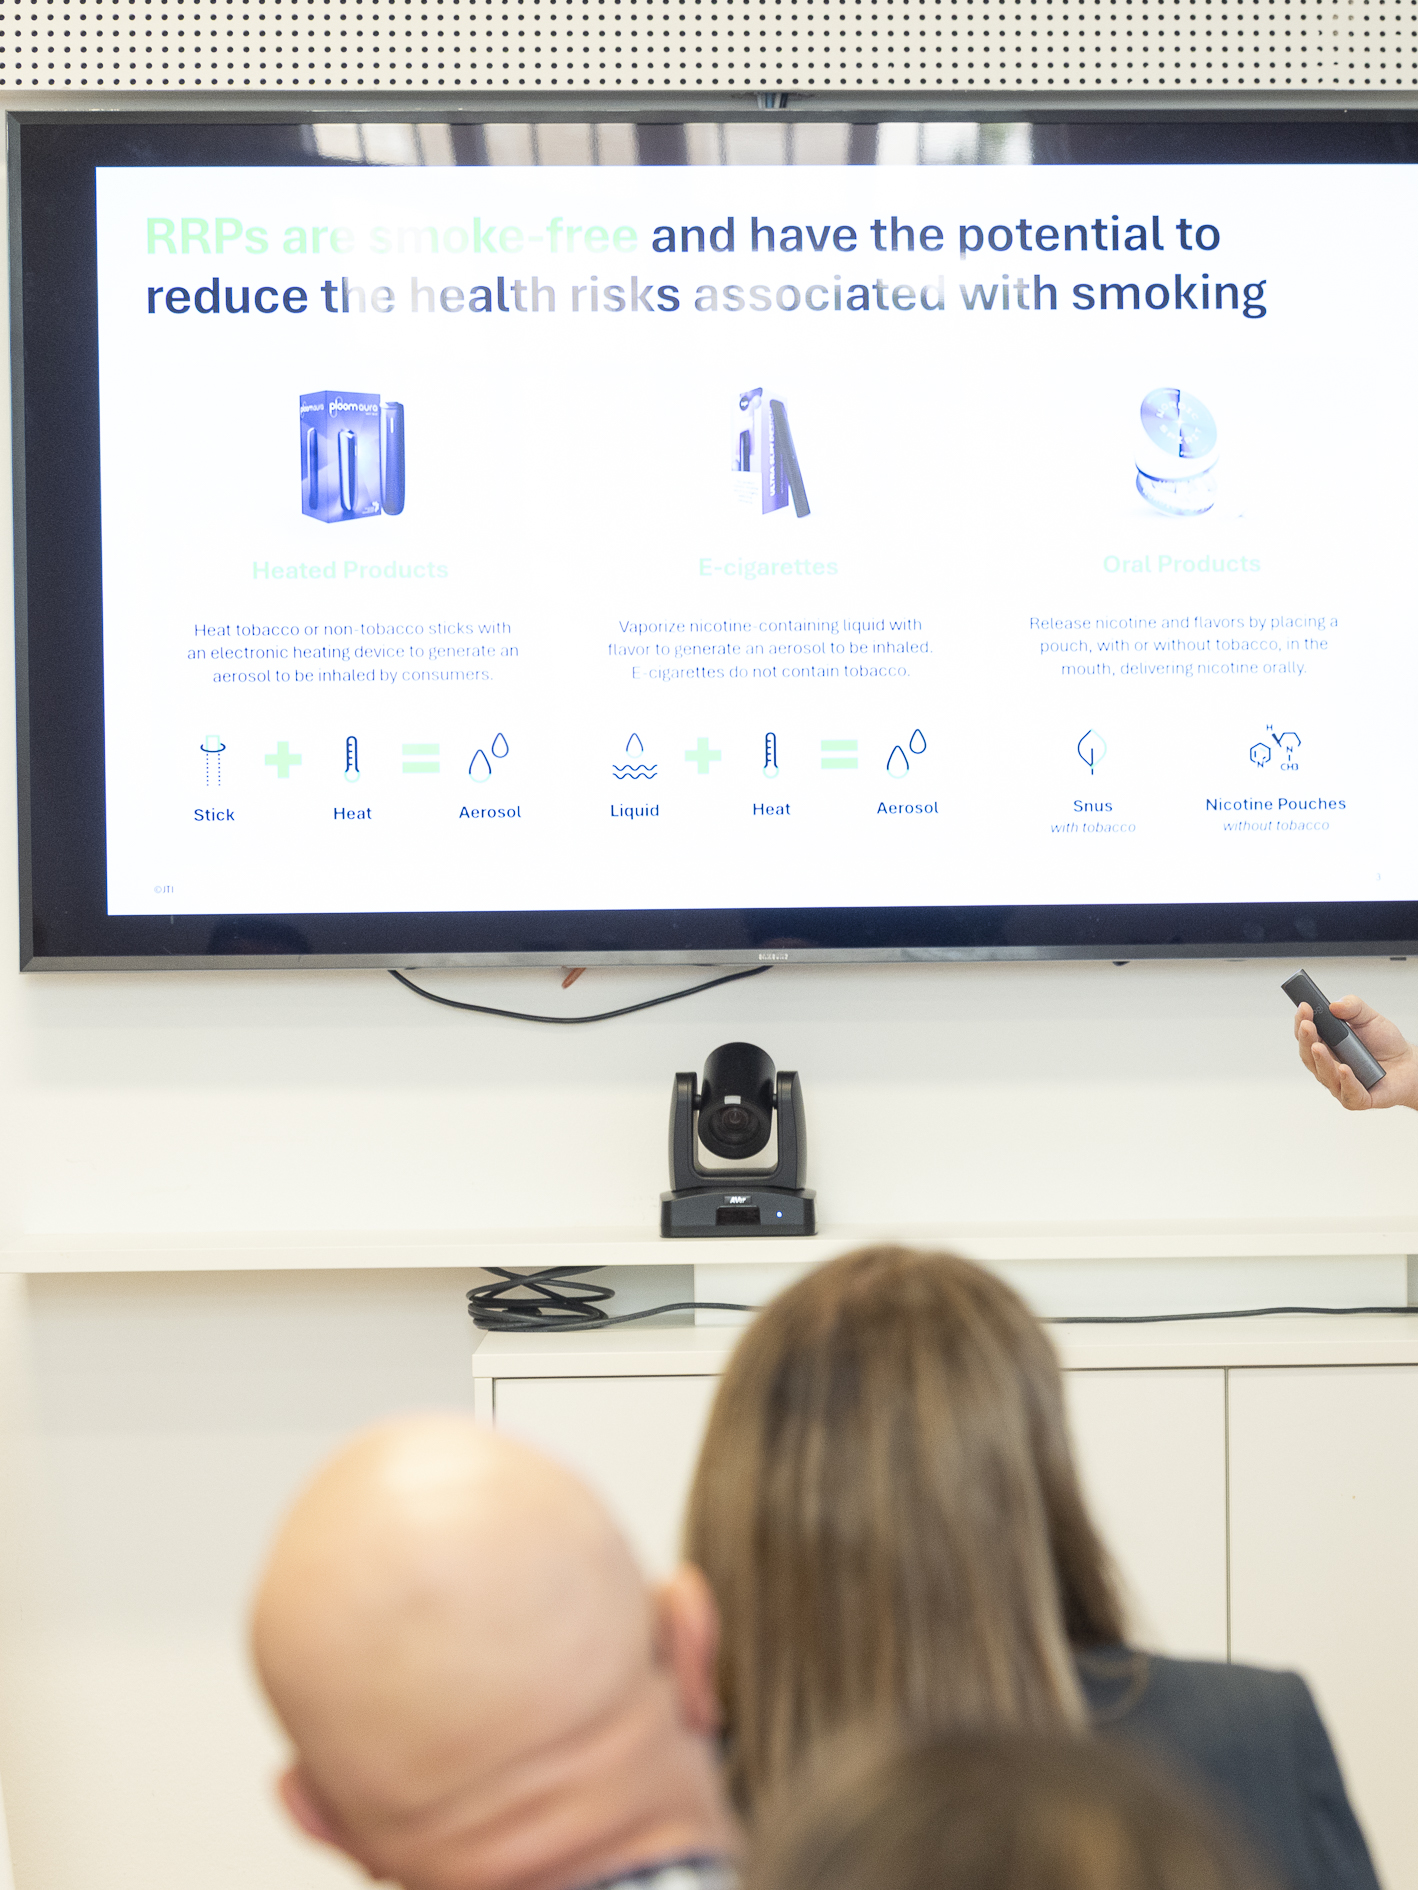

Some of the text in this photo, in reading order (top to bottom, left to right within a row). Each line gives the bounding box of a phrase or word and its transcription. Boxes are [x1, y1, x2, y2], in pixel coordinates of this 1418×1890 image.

[146, 214, 1221, 259] RRPs are smoke-free and have the potential to
[147, 272, 1267, 320] reduce the health risks associated with smoking
[252, 560, 449, 580] Heated Products
[699, 557, 839, 581] E-cigarettes
[1103, 554, 1261, 574] Oral Products
[194, 624, 231, 637] Heat
[236, 624, 300, 636] tobacco
[304, 625, 319, 636] or
[429, 622, 474, 634] sticks
[478, 621, 511, 634] with
[619, 620, 685, 636] Vaporize
[843, 619, 885, 635] liquid
[889, 618, 922, 631] with
[1030, 616, 1338, 631] Release nicotine and flavors by placing a
[187, 645, 519, 661] an electronic heating device to generate an
[608, 641, 933, 658] flavor to generate an aerosol to be inhaled.
[1040, 638, 1328, 655] pouch, with or without tobacco, in the
[213, 668, 493, 684] aerosol to be inhaled by consumers.
[729, 665, 748, 678] do
[753, 666, 777, 678] not
[782, 666, 839, 678] contain
[844, 664, 910, 677] tobacco.
[1061, 661, 1306, 678] mouth, delivering nicotine orally.
[459, 805, 521, 819] Aerosol
[610, 803, 659, 820] Liquid
[753, 803, 791, 816] Heat
[876, 801, 939, 814] Aerosol
[1073, 799, 1113, 813] Snus
[1206, 797, 1346, 811] Nicotine Pouches
[194, 807, 235, 822] Stick
[333, 807, 372, 820] Heat
[1051, 822, 1136, 833] with tobacco
[1223, 820, 1330, 831] without tobacco
